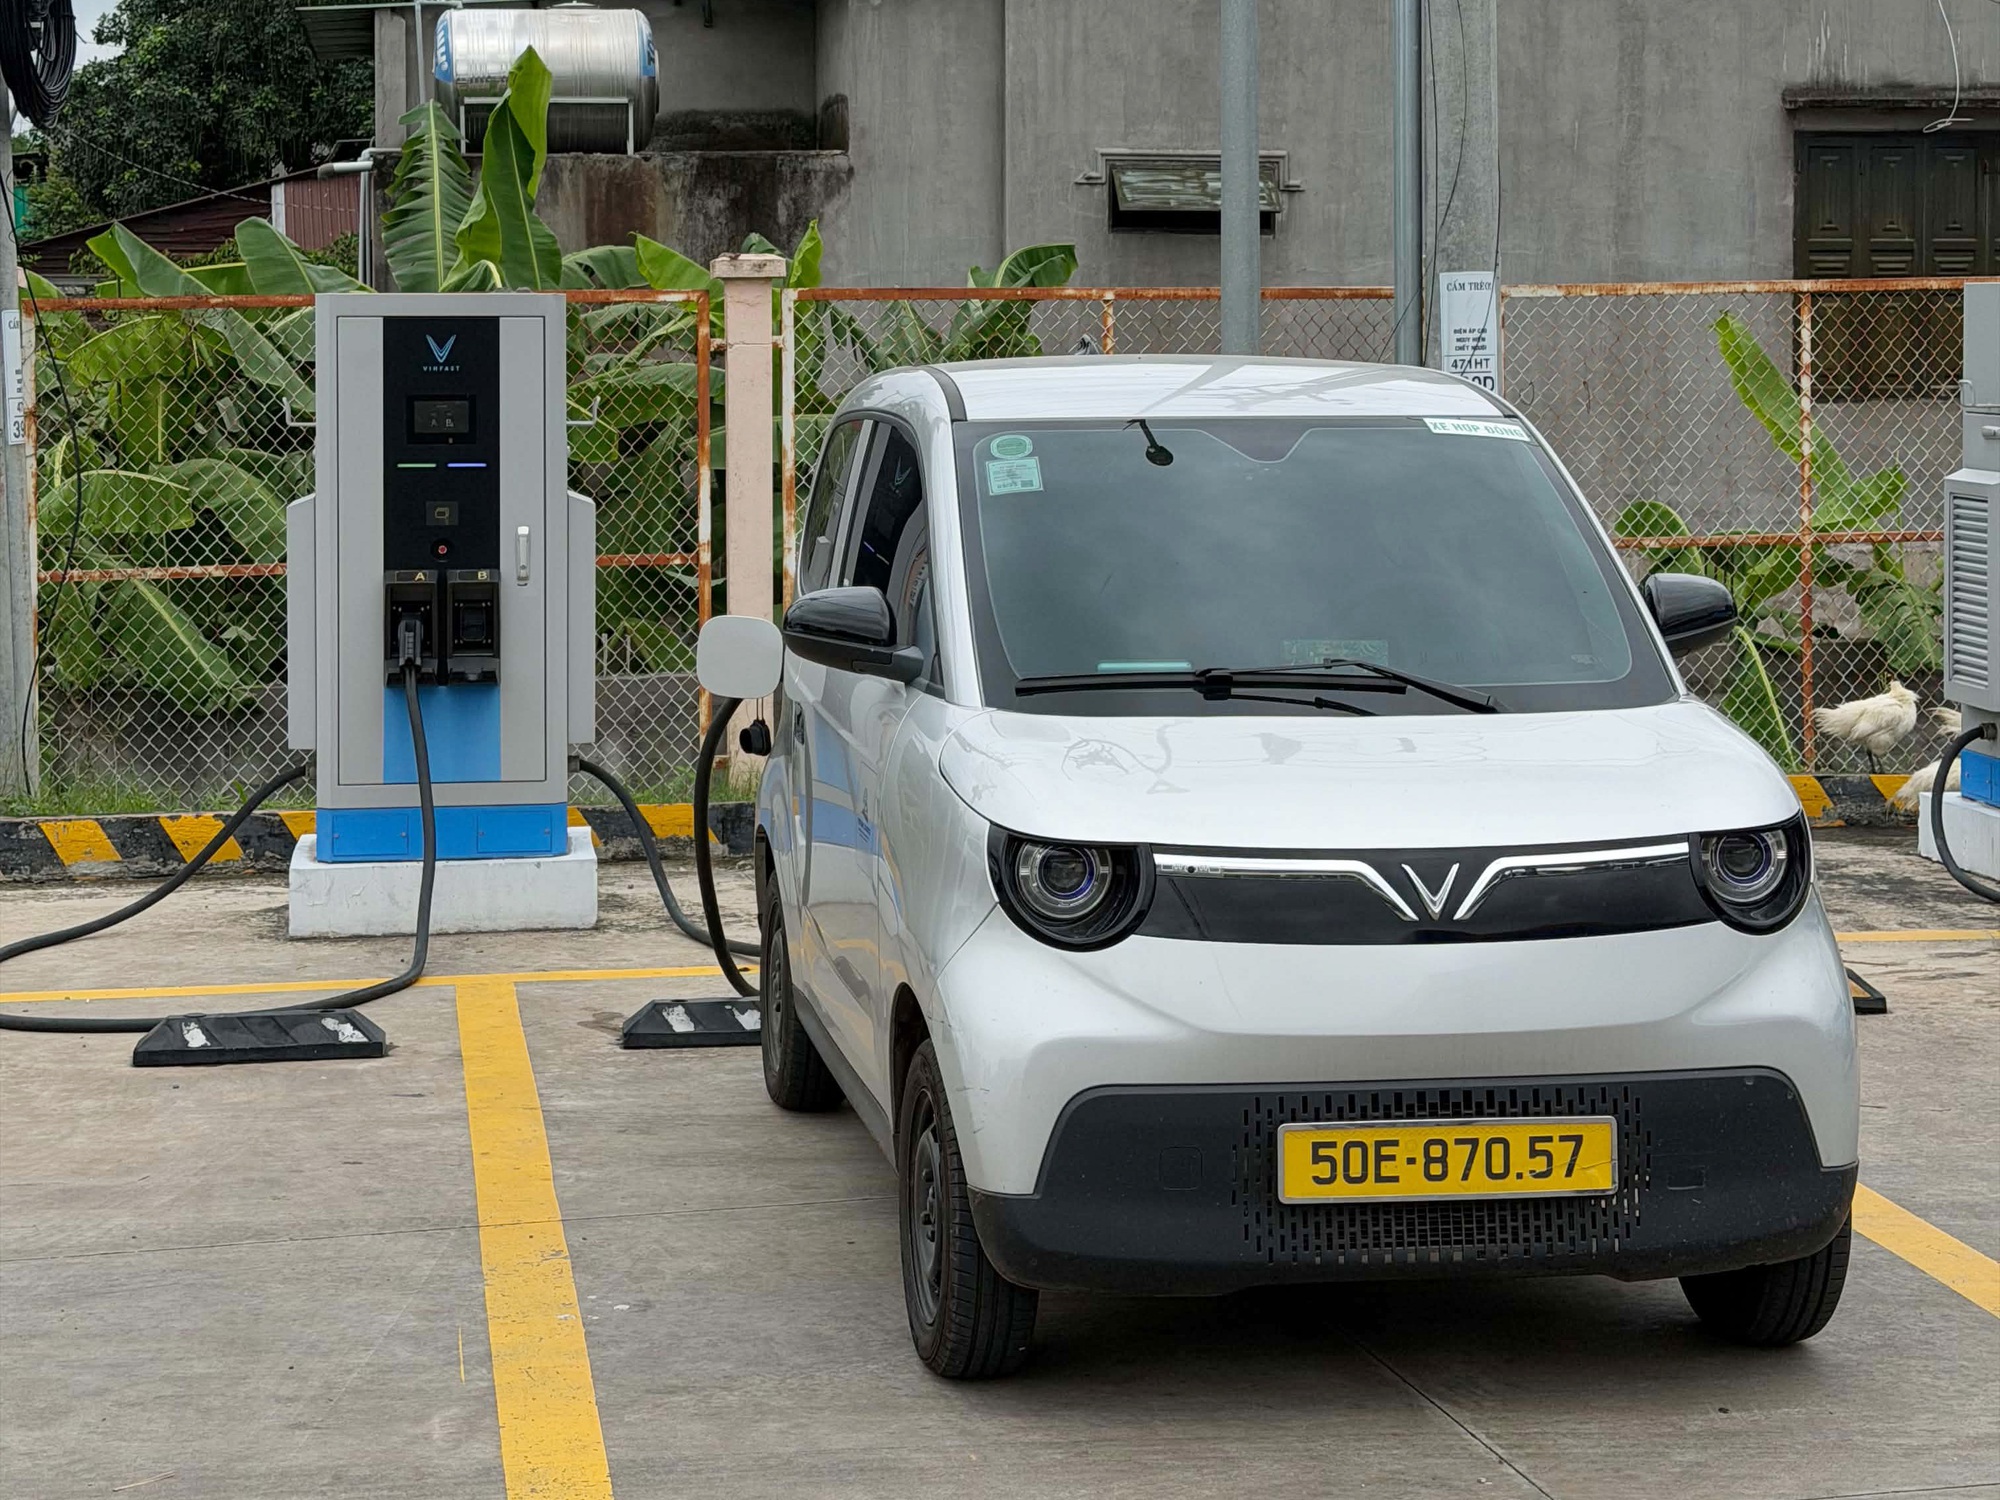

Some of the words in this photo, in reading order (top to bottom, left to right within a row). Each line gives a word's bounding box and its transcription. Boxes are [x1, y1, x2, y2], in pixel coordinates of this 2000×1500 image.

[1428, 421, 1449, 431] XE
[415, 572, 426, 581] A
[477, 571, 488, 580] B
[1311, 1134, 1584, 1185] 50E-870.57
